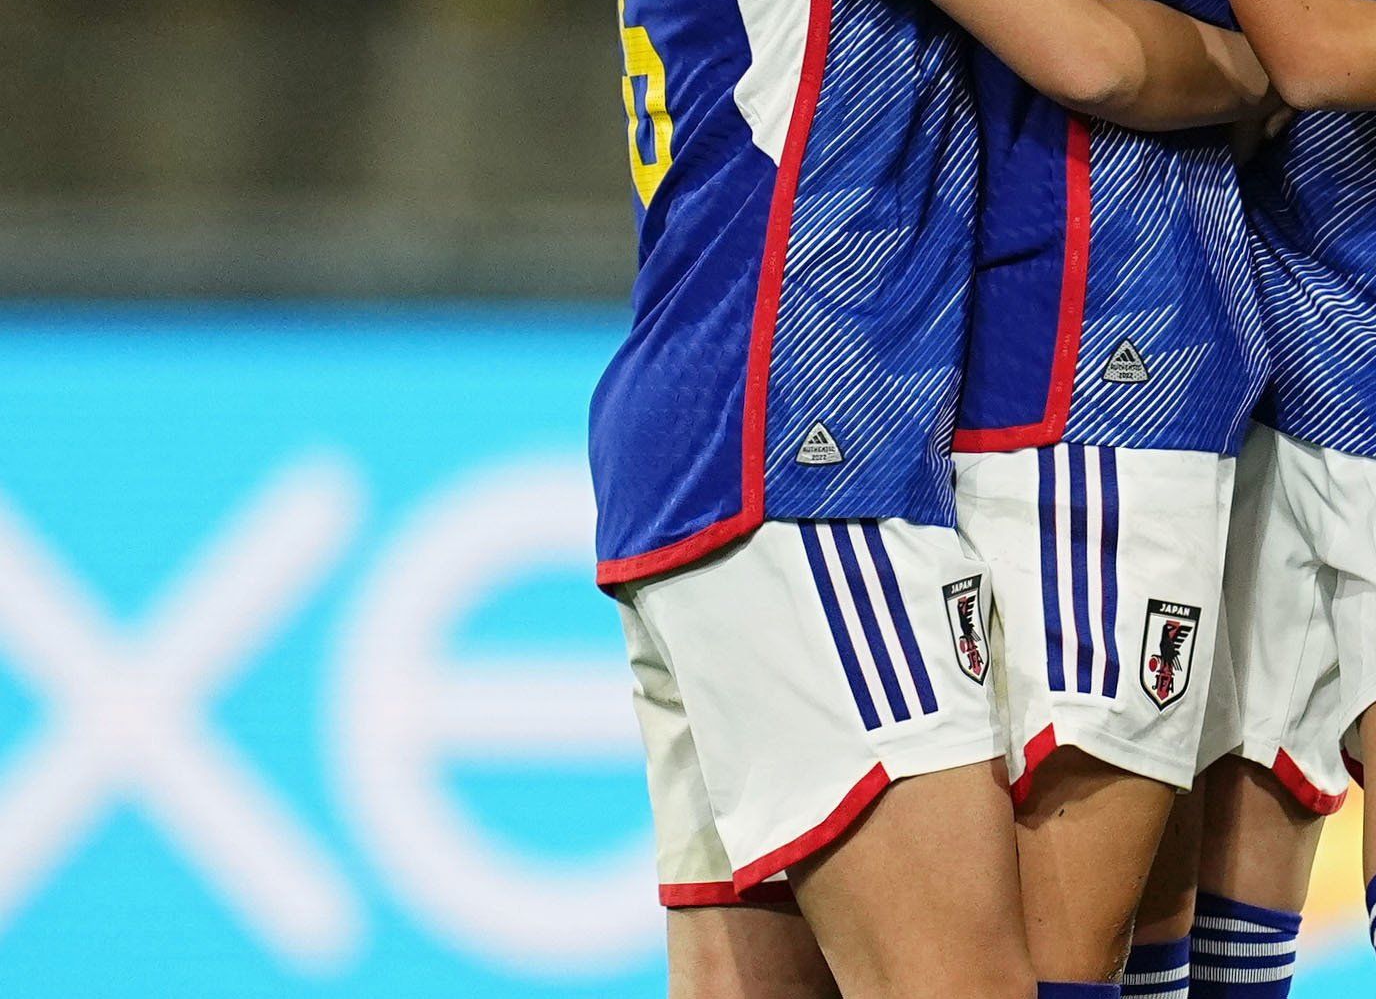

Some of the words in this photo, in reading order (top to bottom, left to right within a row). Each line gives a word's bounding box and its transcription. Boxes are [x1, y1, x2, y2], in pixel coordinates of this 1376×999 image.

[951, 579, 973, 595] JAPAN
[1160, 603, 1190, 617] JAPAN
[1151, 673, 1175, 694] JFA
